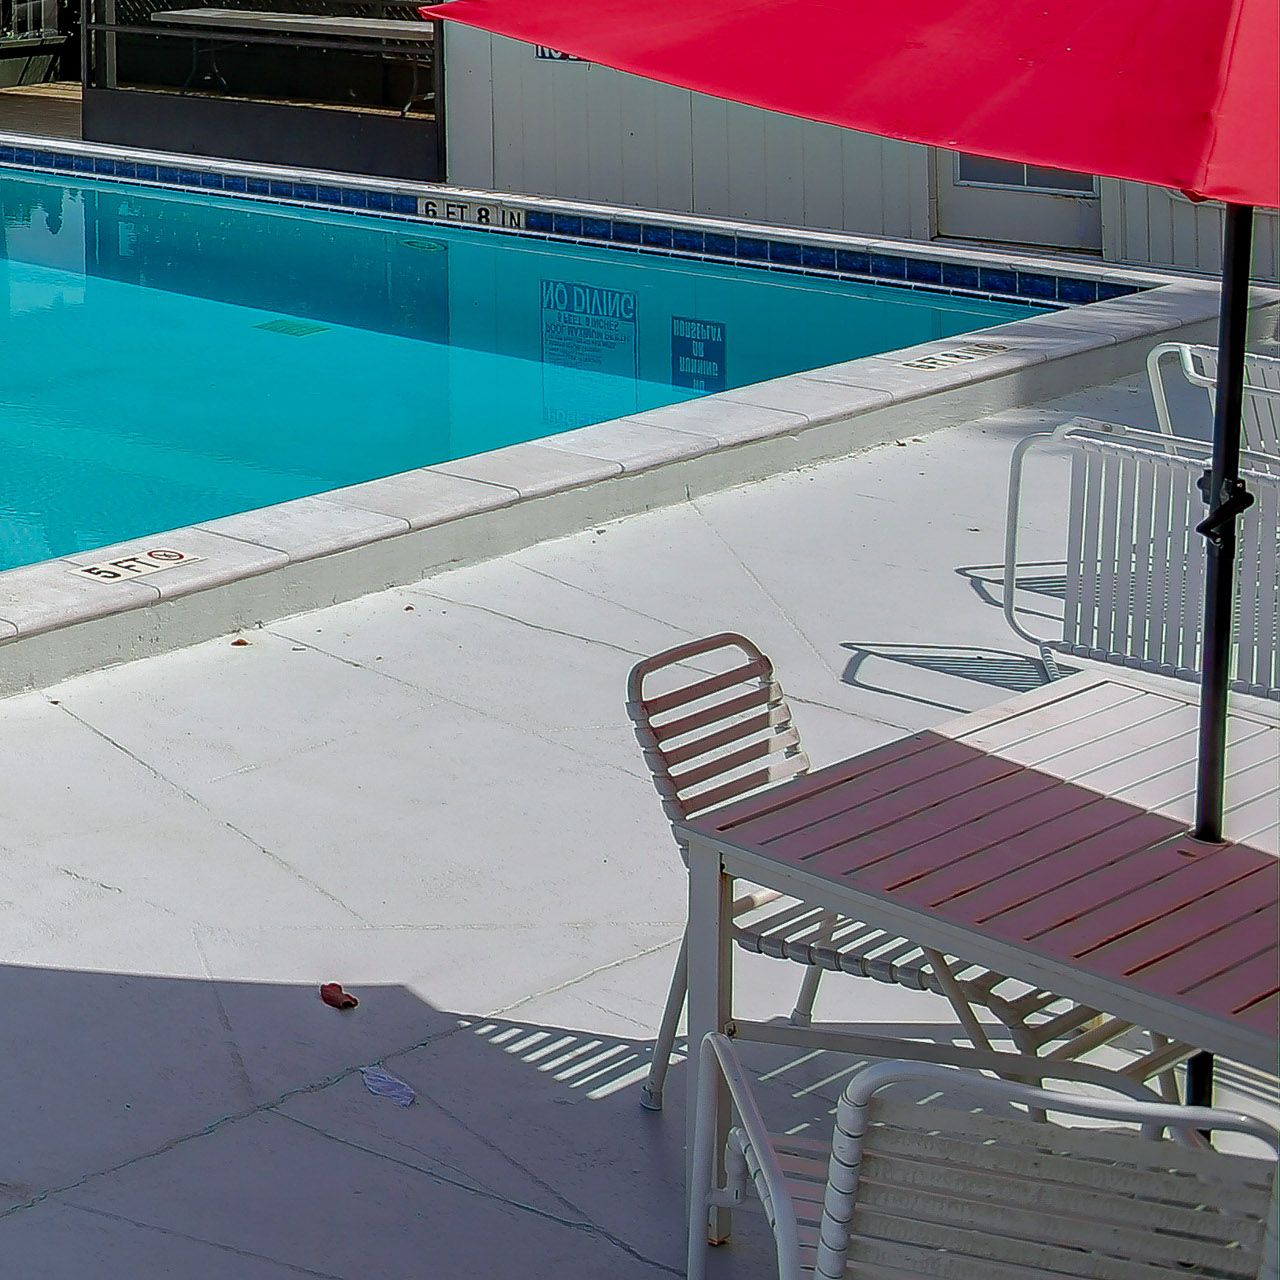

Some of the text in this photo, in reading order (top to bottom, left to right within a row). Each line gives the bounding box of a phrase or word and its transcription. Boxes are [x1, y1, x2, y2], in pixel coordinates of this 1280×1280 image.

[424, 201, 521, 228] 6 FT 8 IN
[916, 357, 958, 366] FT
[81, 567, 121, 578] 5
[109, 558, 160, 573] FT
